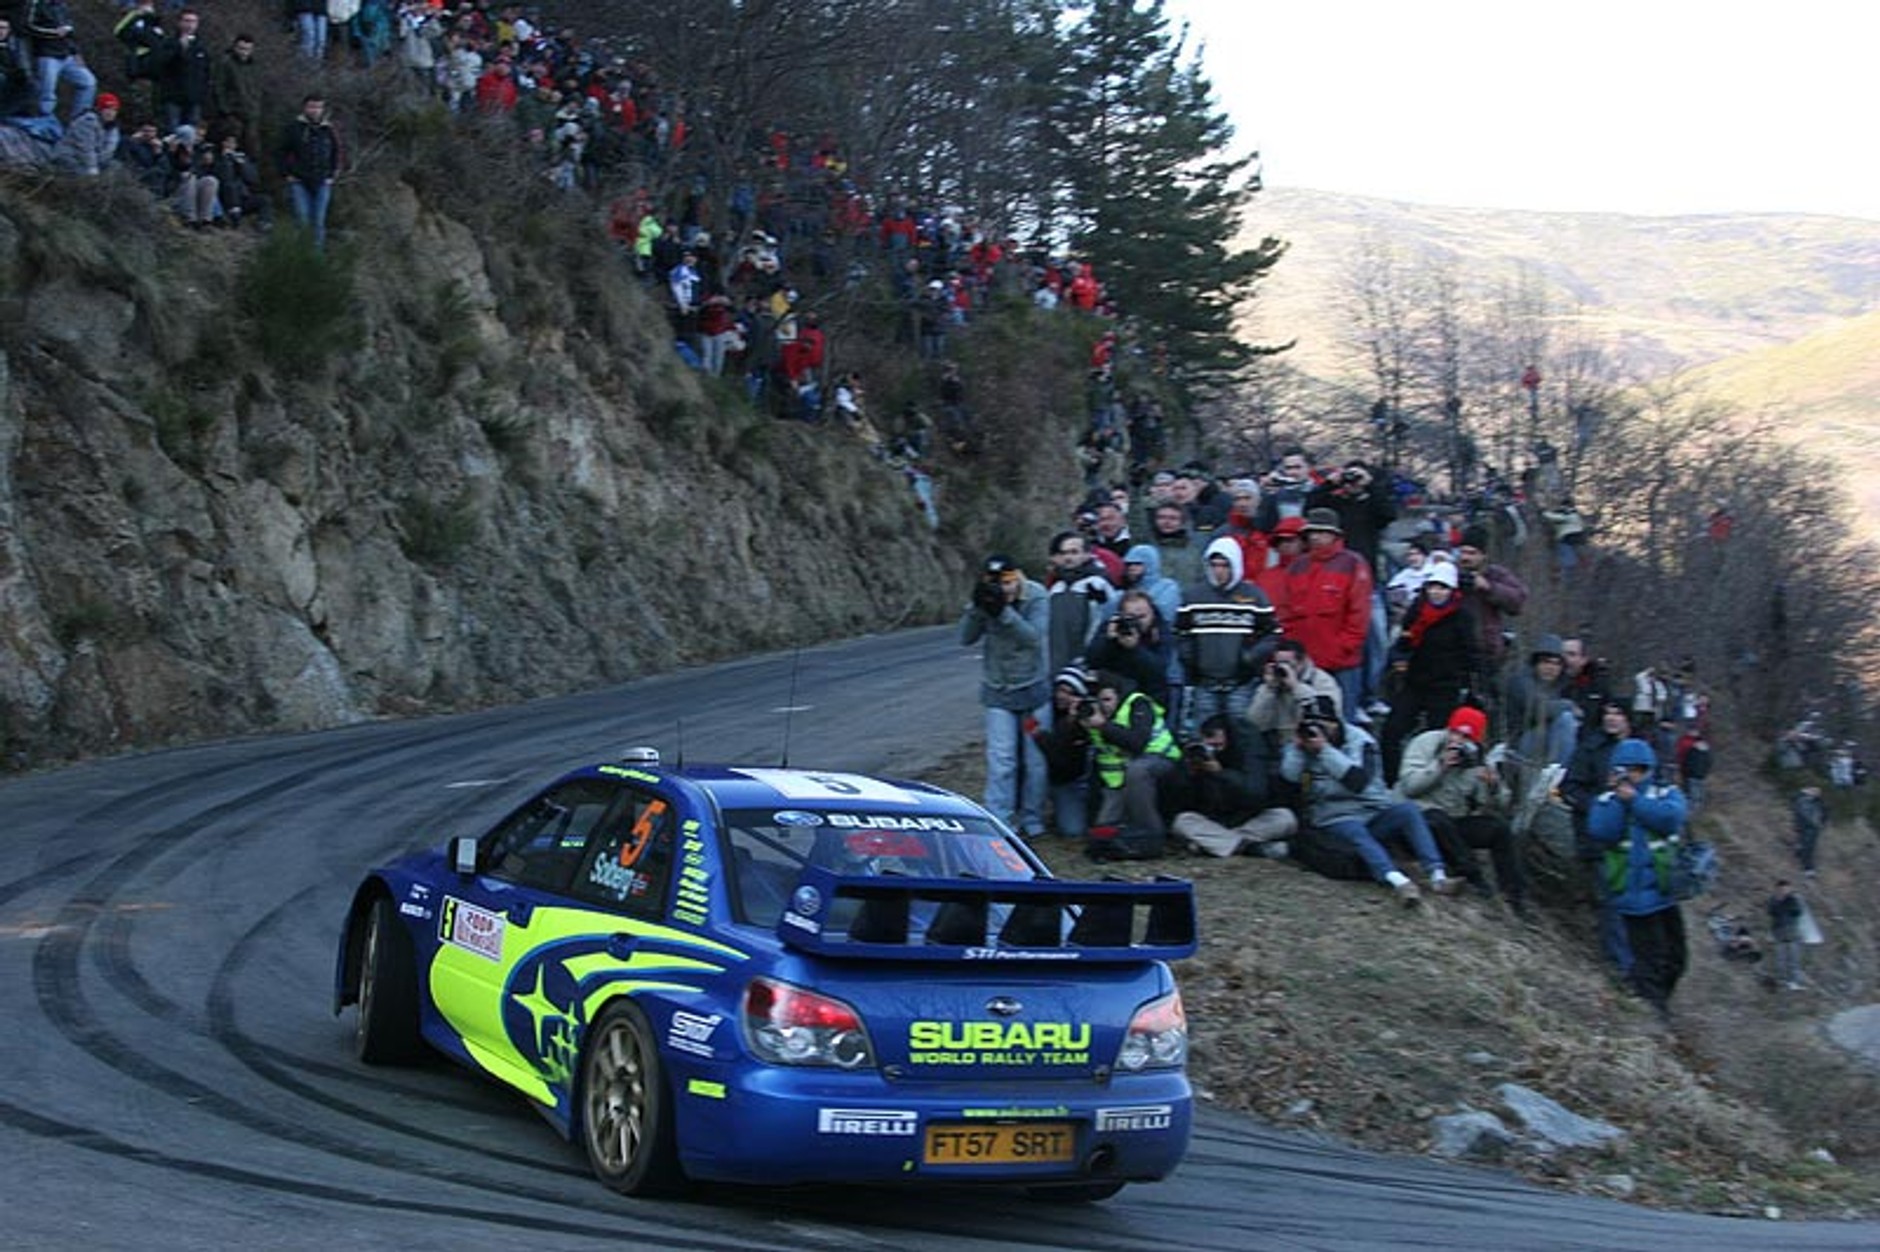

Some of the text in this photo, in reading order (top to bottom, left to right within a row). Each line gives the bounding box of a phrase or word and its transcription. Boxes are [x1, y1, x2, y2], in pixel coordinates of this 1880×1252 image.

[619, 799, 667, 867] 5
[827, 813, 965, 833] SUBARU
[909, 1021, 1091, 1050] SUBARU
[910, 1052, 1089, 1064] WORLD RALLY TEAM
[818, 1108, 918, 1135] PIRELLI
[1095, 1105, 1172, 1131] PIRELLI
[931, 1131, 1066, 1157] FT57 SRT
